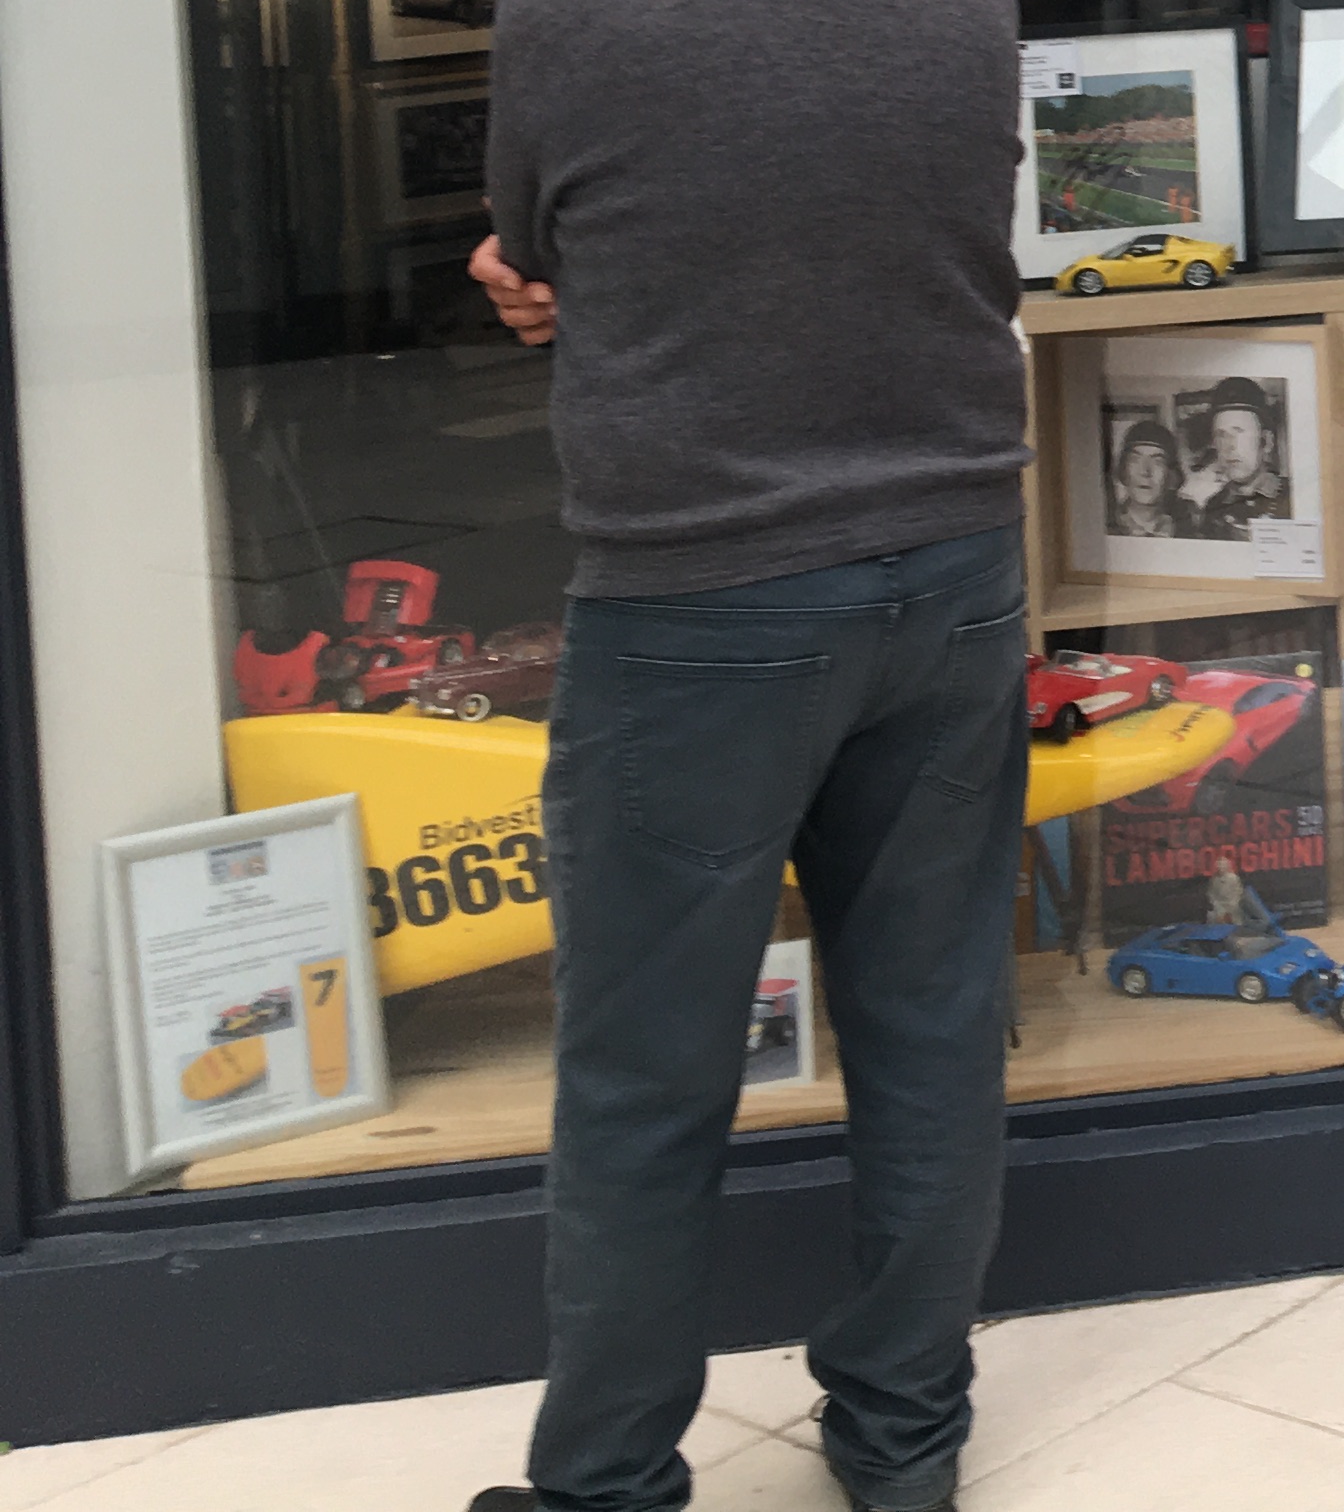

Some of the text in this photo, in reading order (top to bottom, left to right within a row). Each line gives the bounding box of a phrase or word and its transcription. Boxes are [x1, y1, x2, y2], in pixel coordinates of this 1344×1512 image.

[419, 802, 541, 850] Bidvest
[1106, 808, 1294, 854] SUPERCARS
[1105, 835, 1325, 887] LAMBORGHINI
[310, 968, 338, 1007] 7
